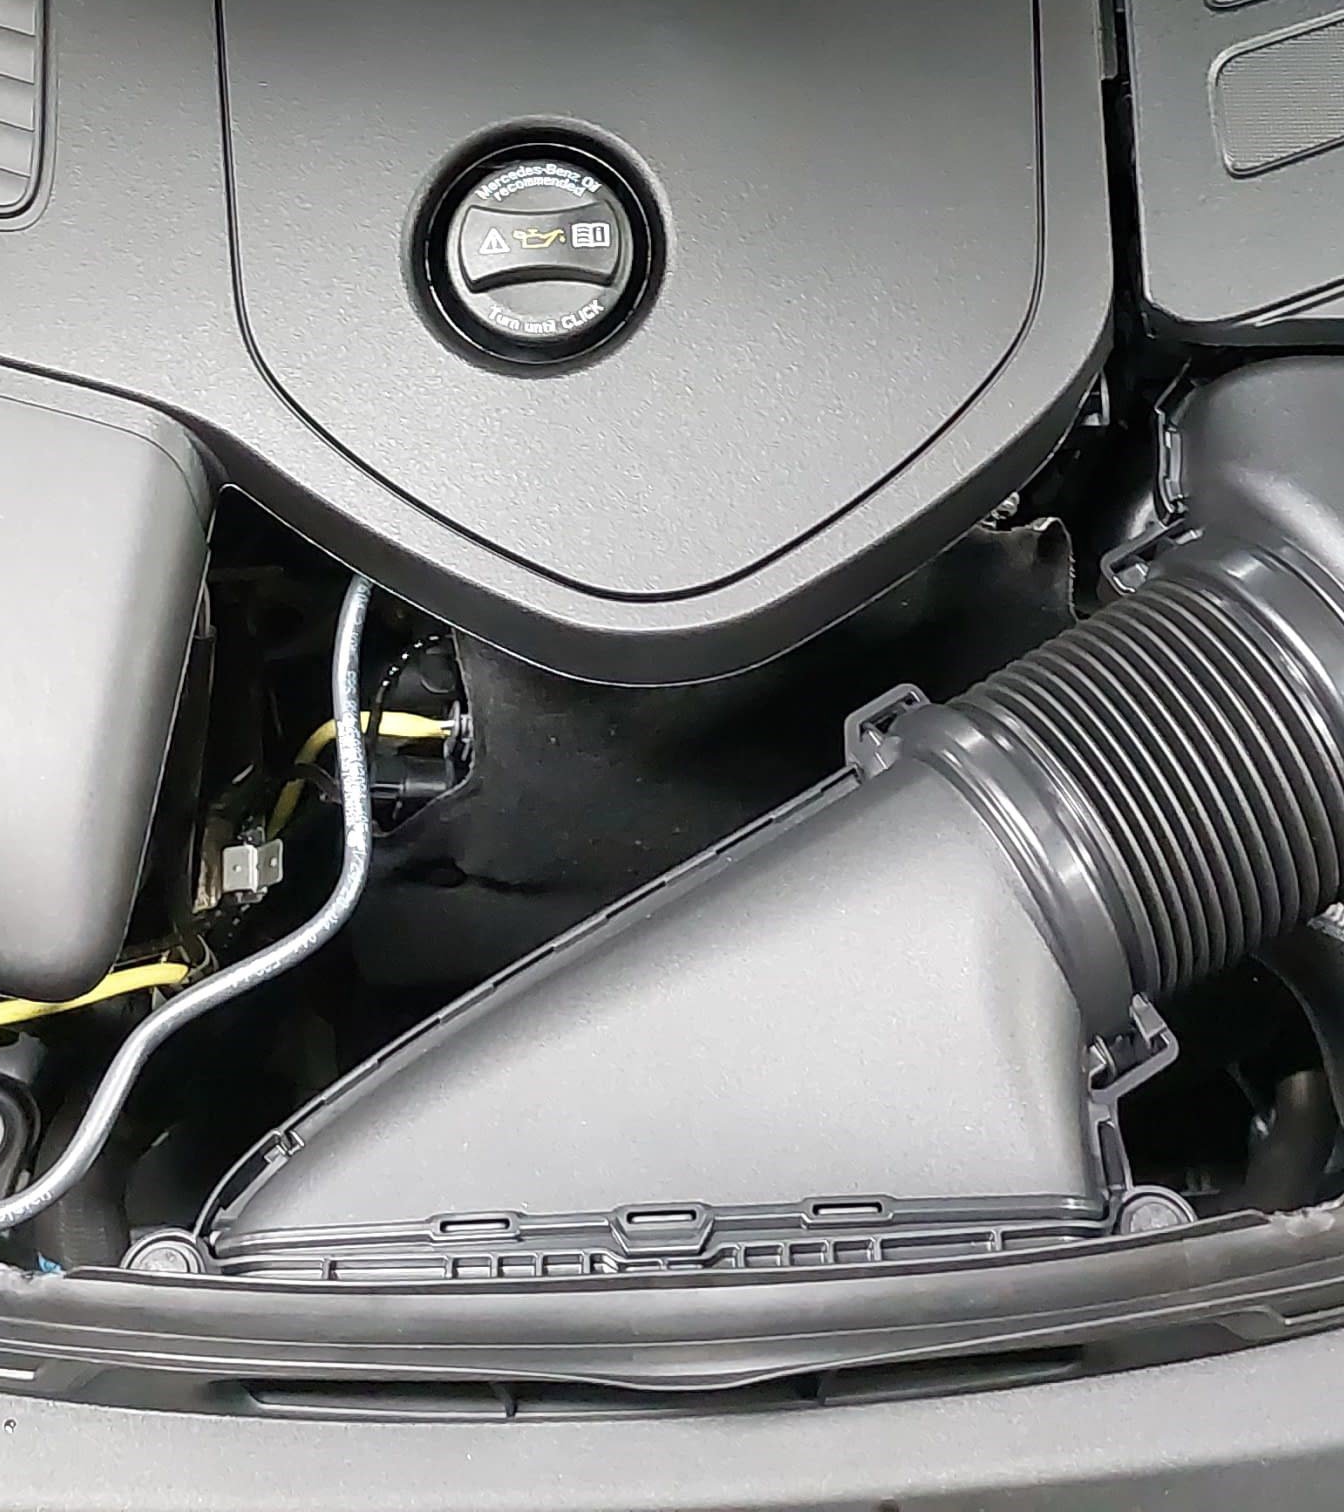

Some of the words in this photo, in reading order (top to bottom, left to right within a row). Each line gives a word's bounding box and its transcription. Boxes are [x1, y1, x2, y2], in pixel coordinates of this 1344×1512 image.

[475, 163, 581, 200] Mercedes-Benz
[581, 176, 603, 193] Oil
[494, 176, 586, 201] recommended
[488, 304, 520, 330] Turn
[560, 299, 605, 330] CLICK
